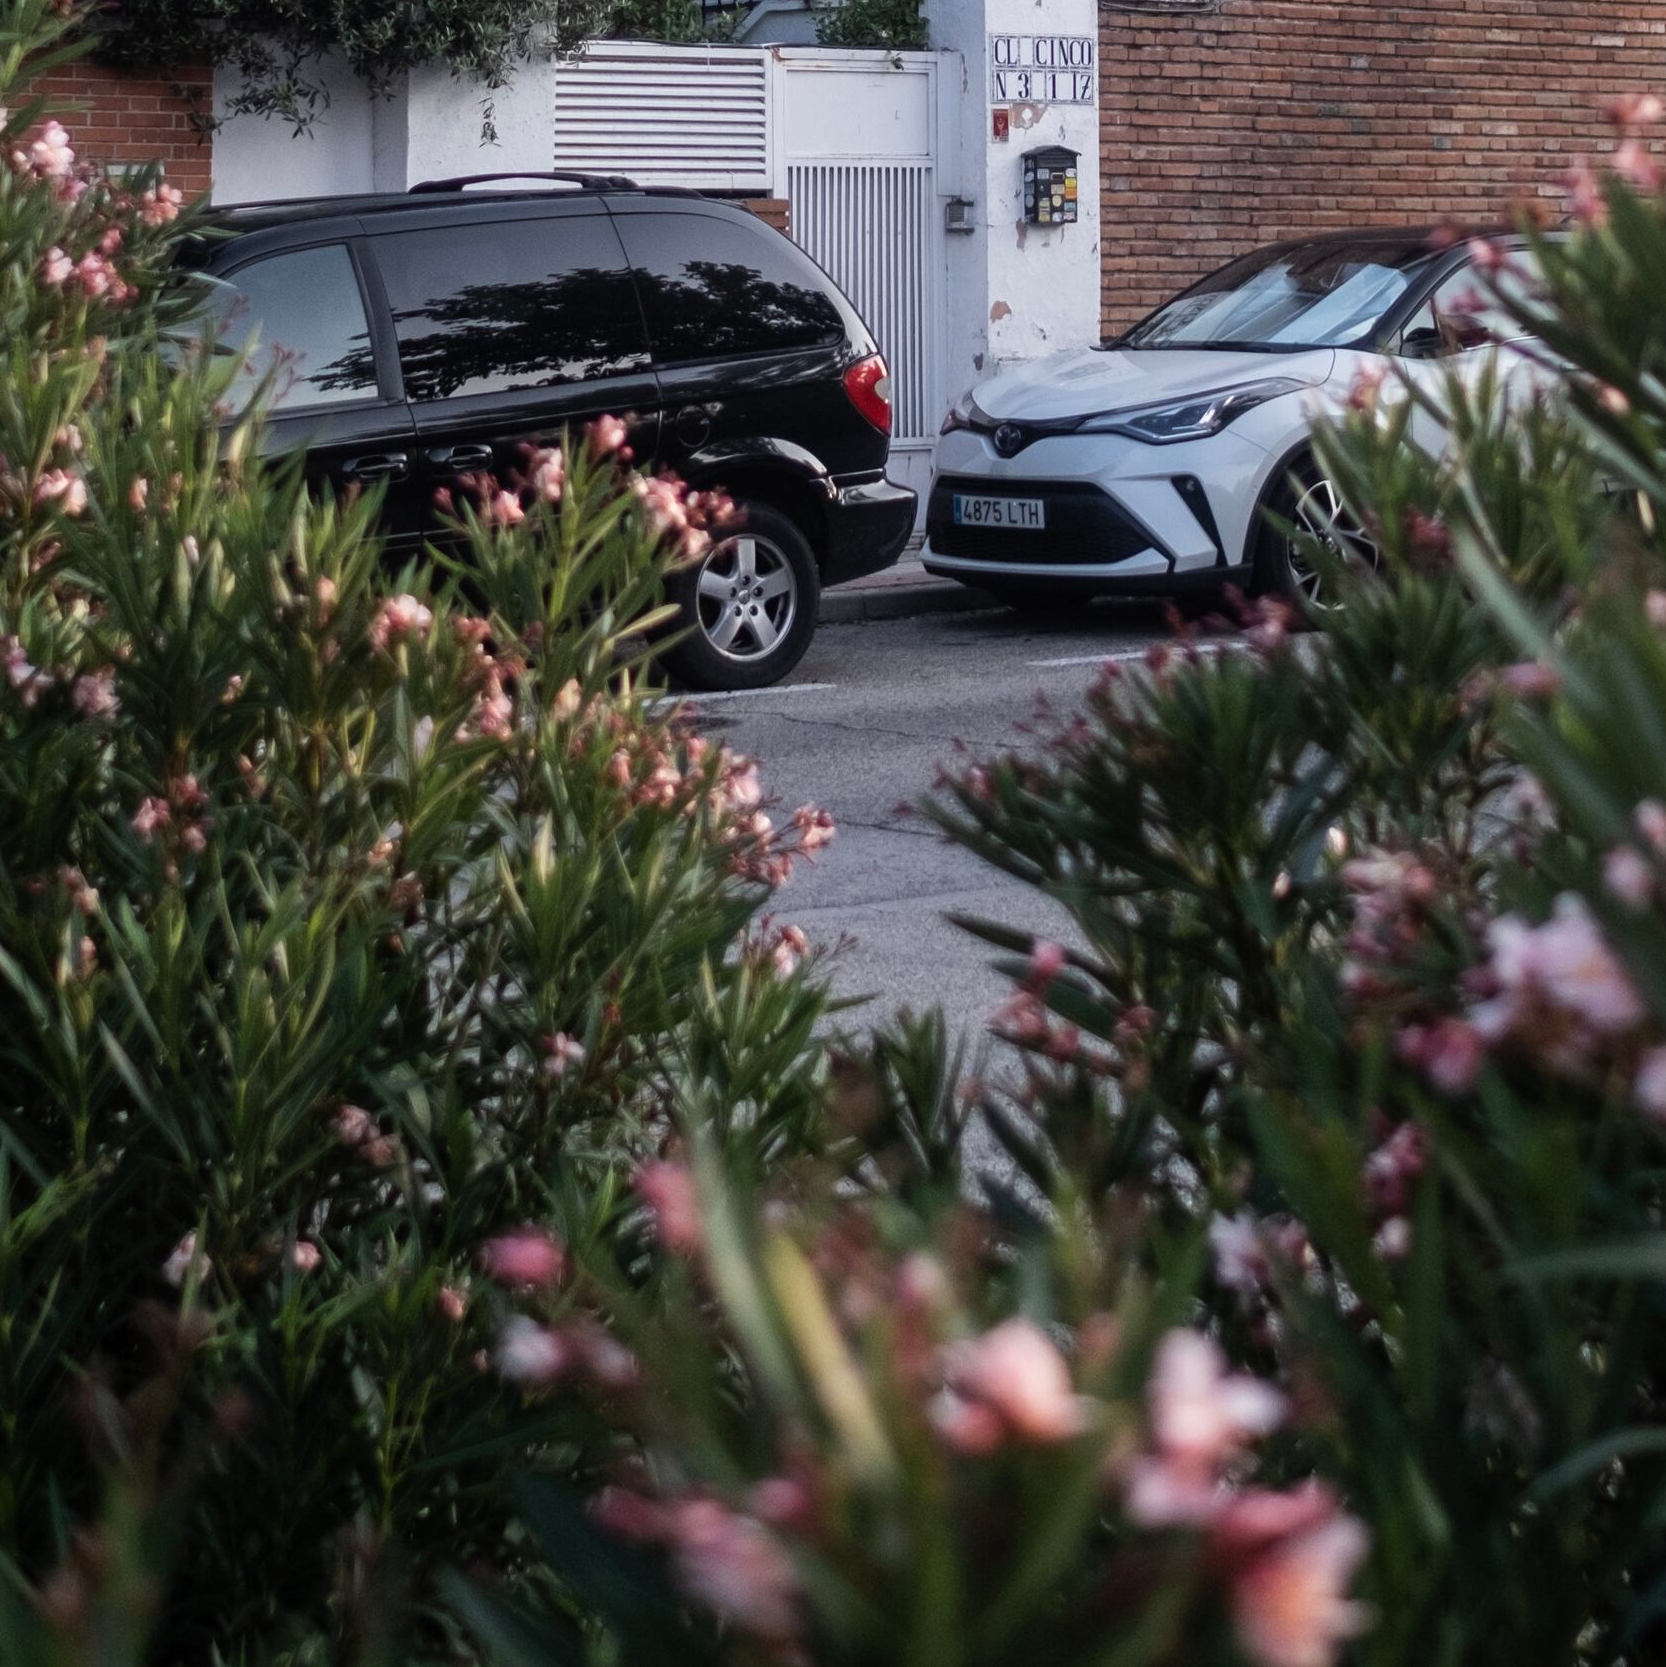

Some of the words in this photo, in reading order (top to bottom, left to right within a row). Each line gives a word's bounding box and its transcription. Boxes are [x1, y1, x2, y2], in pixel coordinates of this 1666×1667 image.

[994, 38, 1017, 65] CL
[1035, 39, 1092, 66] CINCO
[996, 72, 1006, 99] N
[1017, 72, 1029, 99] 3
[963, 499, 1002, 522] 4875
[1007, 501, 1039, 525] LTH
